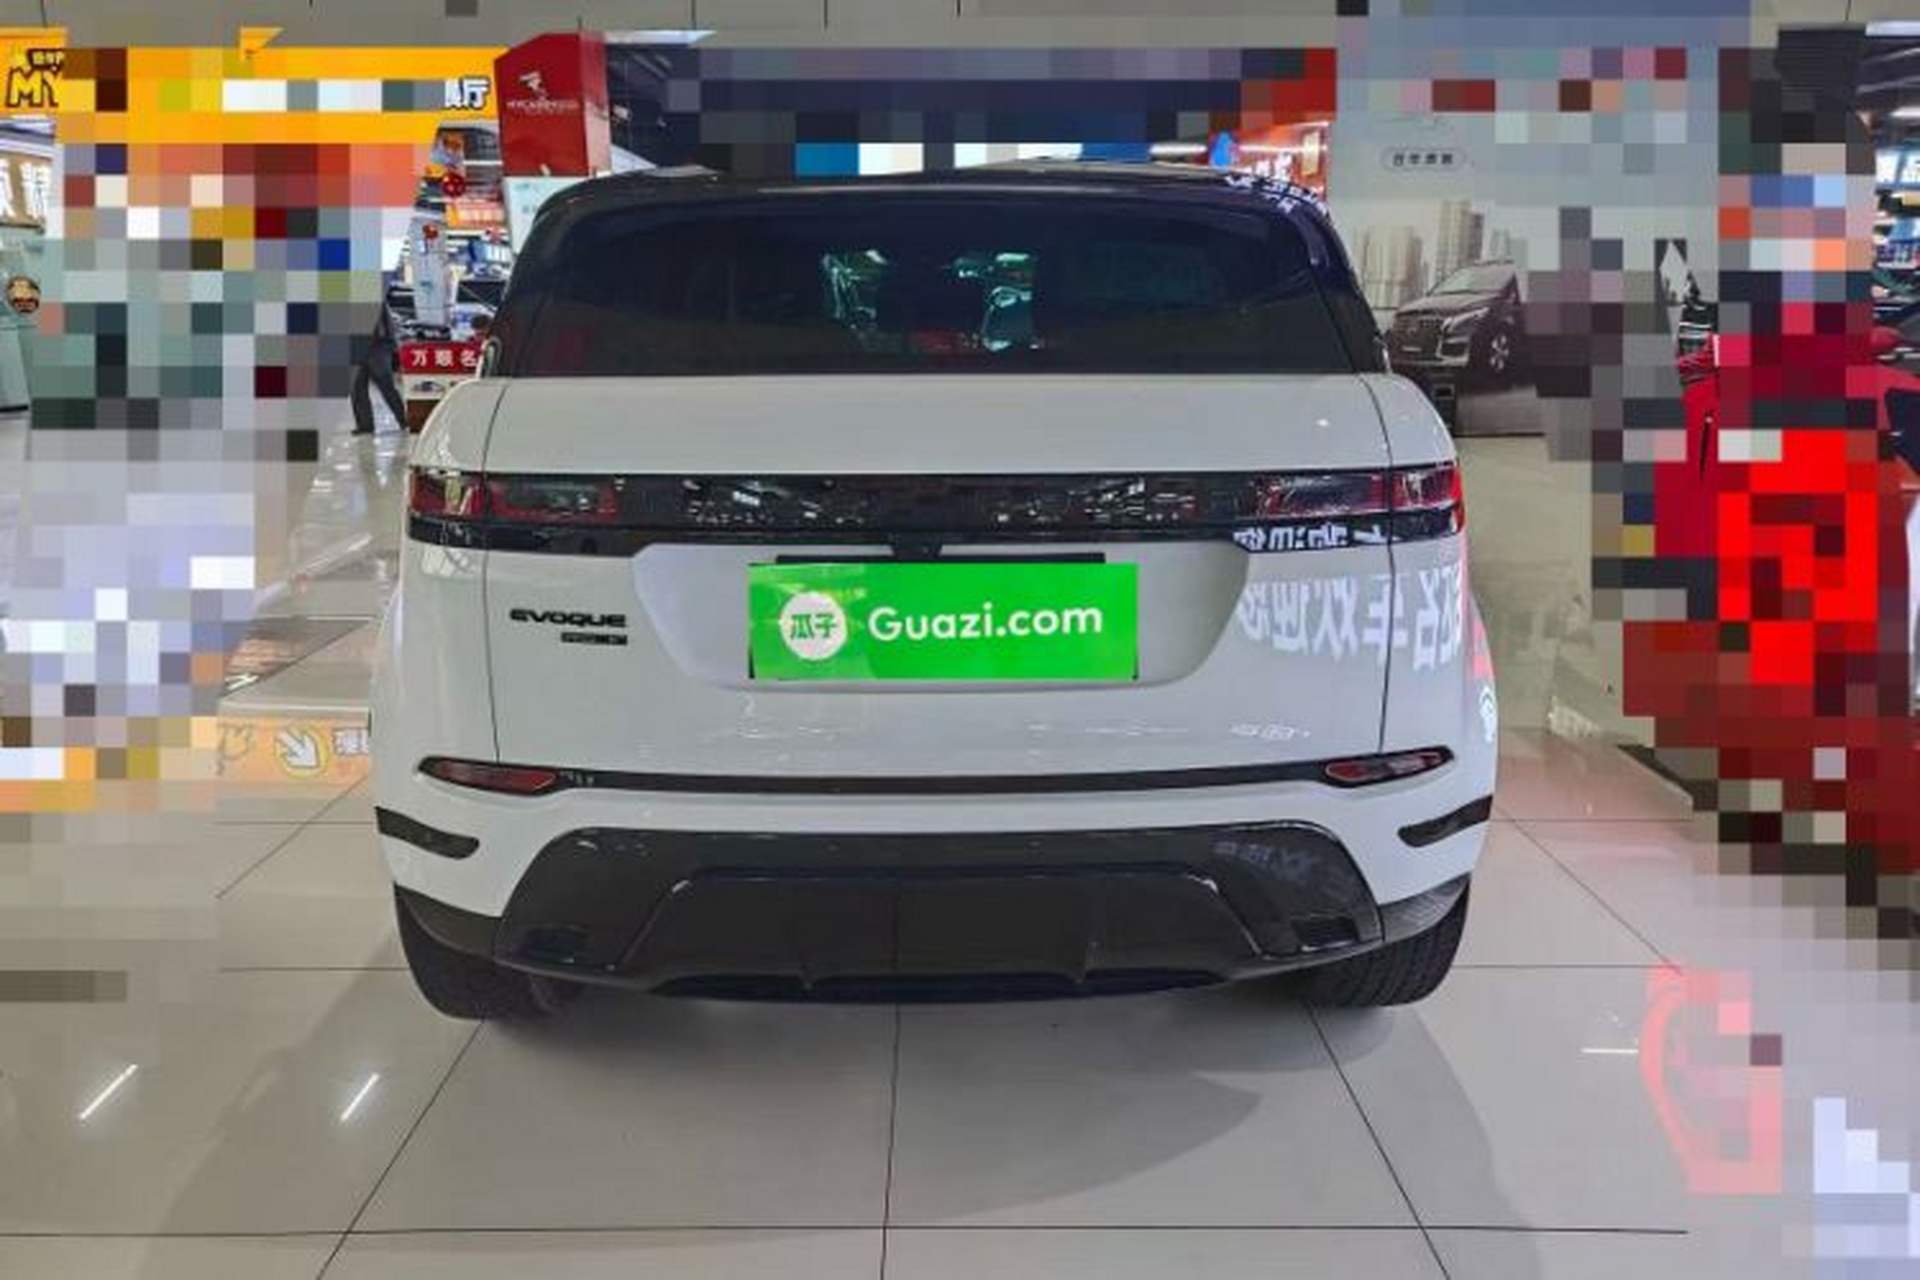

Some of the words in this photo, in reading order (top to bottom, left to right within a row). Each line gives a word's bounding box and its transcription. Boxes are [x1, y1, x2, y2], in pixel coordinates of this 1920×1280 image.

[509, 608, 627, 628] EVOQUE
[790, 614, 838, 639] 瓜子
[868, 601, 1103, 642] Guazi.com
